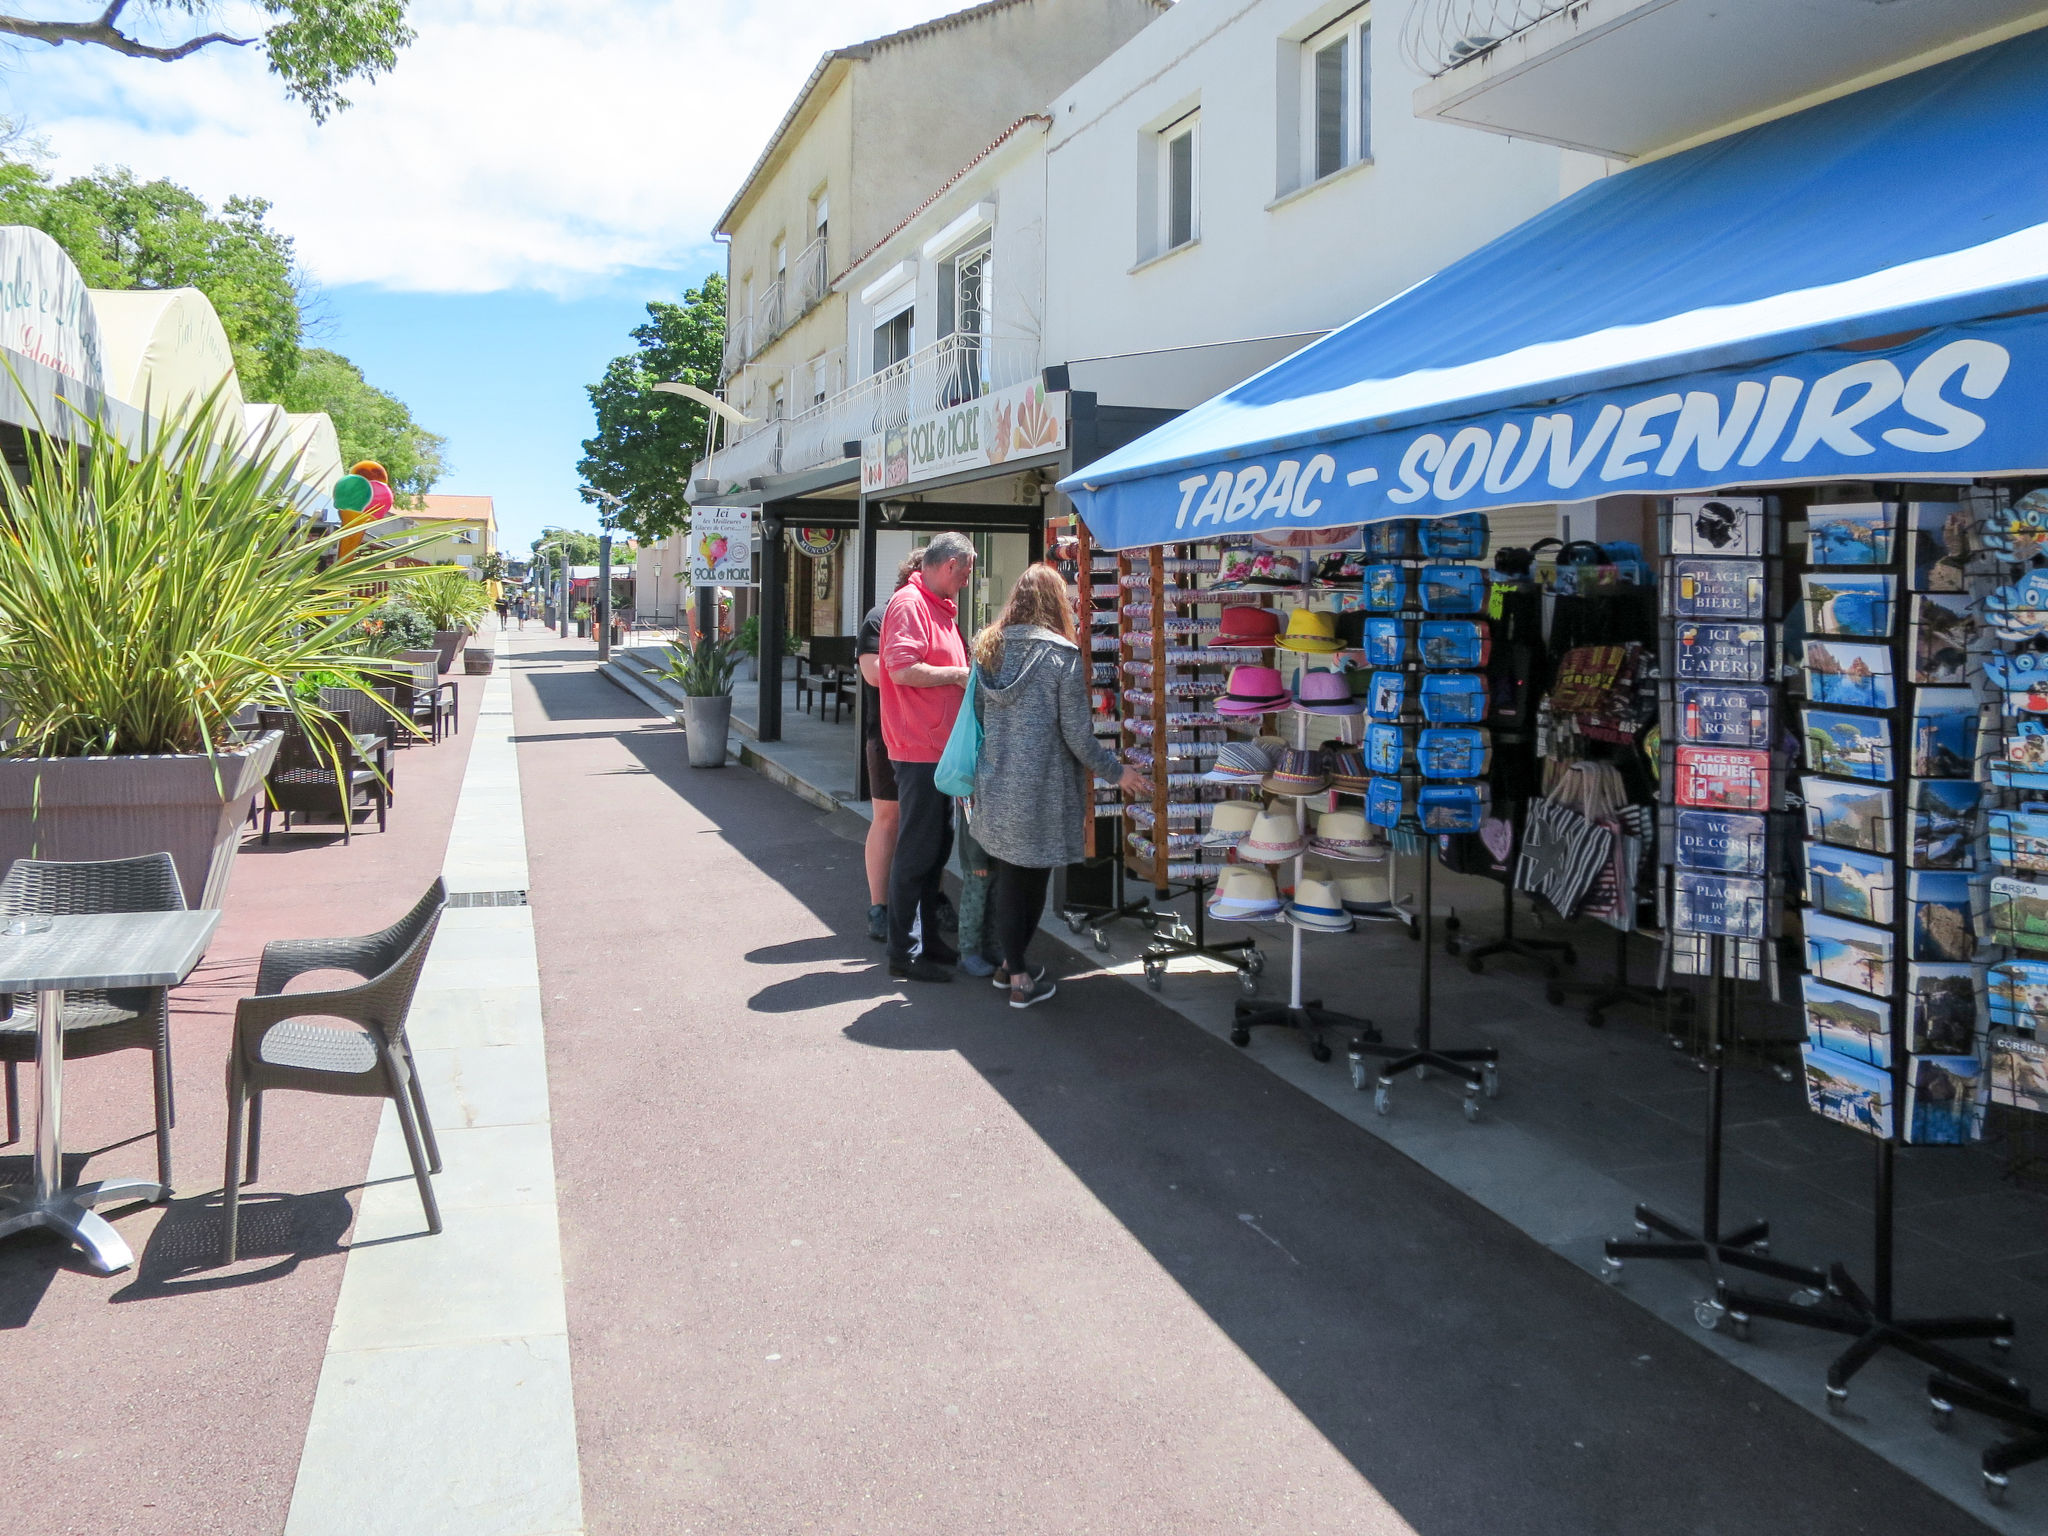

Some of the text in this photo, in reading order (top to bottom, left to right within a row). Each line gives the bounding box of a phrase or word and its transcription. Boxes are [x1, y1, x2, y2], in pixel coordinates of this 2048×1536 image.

[1175, 453, 1336, 530] TABAC
[1387, 338, 2011, 505] SOUVENIRS
[910, 420, 936, 466] SOLE
[715, 508, 729, 518] Ici
[1695, 571, 1742, 583] PLACE
[1720, 585, 1735, 594] LA
[1695, 595, 1742, 610] BIÈRE
[1709, 629, 1730, 641] ICI
[1714, 646, 1747, 657] SERT
[1680, 655, 1758, 674] L'APÉRO
[1702, 695, 1748, 709] PLACE
[1713, 711, 1732, 722] DU
[1704, 721, 1745, 736] ROSÉ
[1694, 753, 1751, 765] PLACE DES
[1689, 763, 1756, 779] POMPIERS
[1707, 822, 1732, 834] WC
[1684, 835, 1758, 850] DE CORSE
[1696, 885, 1744, 900] PLACE
[1993, 882, 2038, 896] CORSICA
[1680, 911, 1722, 926] SUPER
